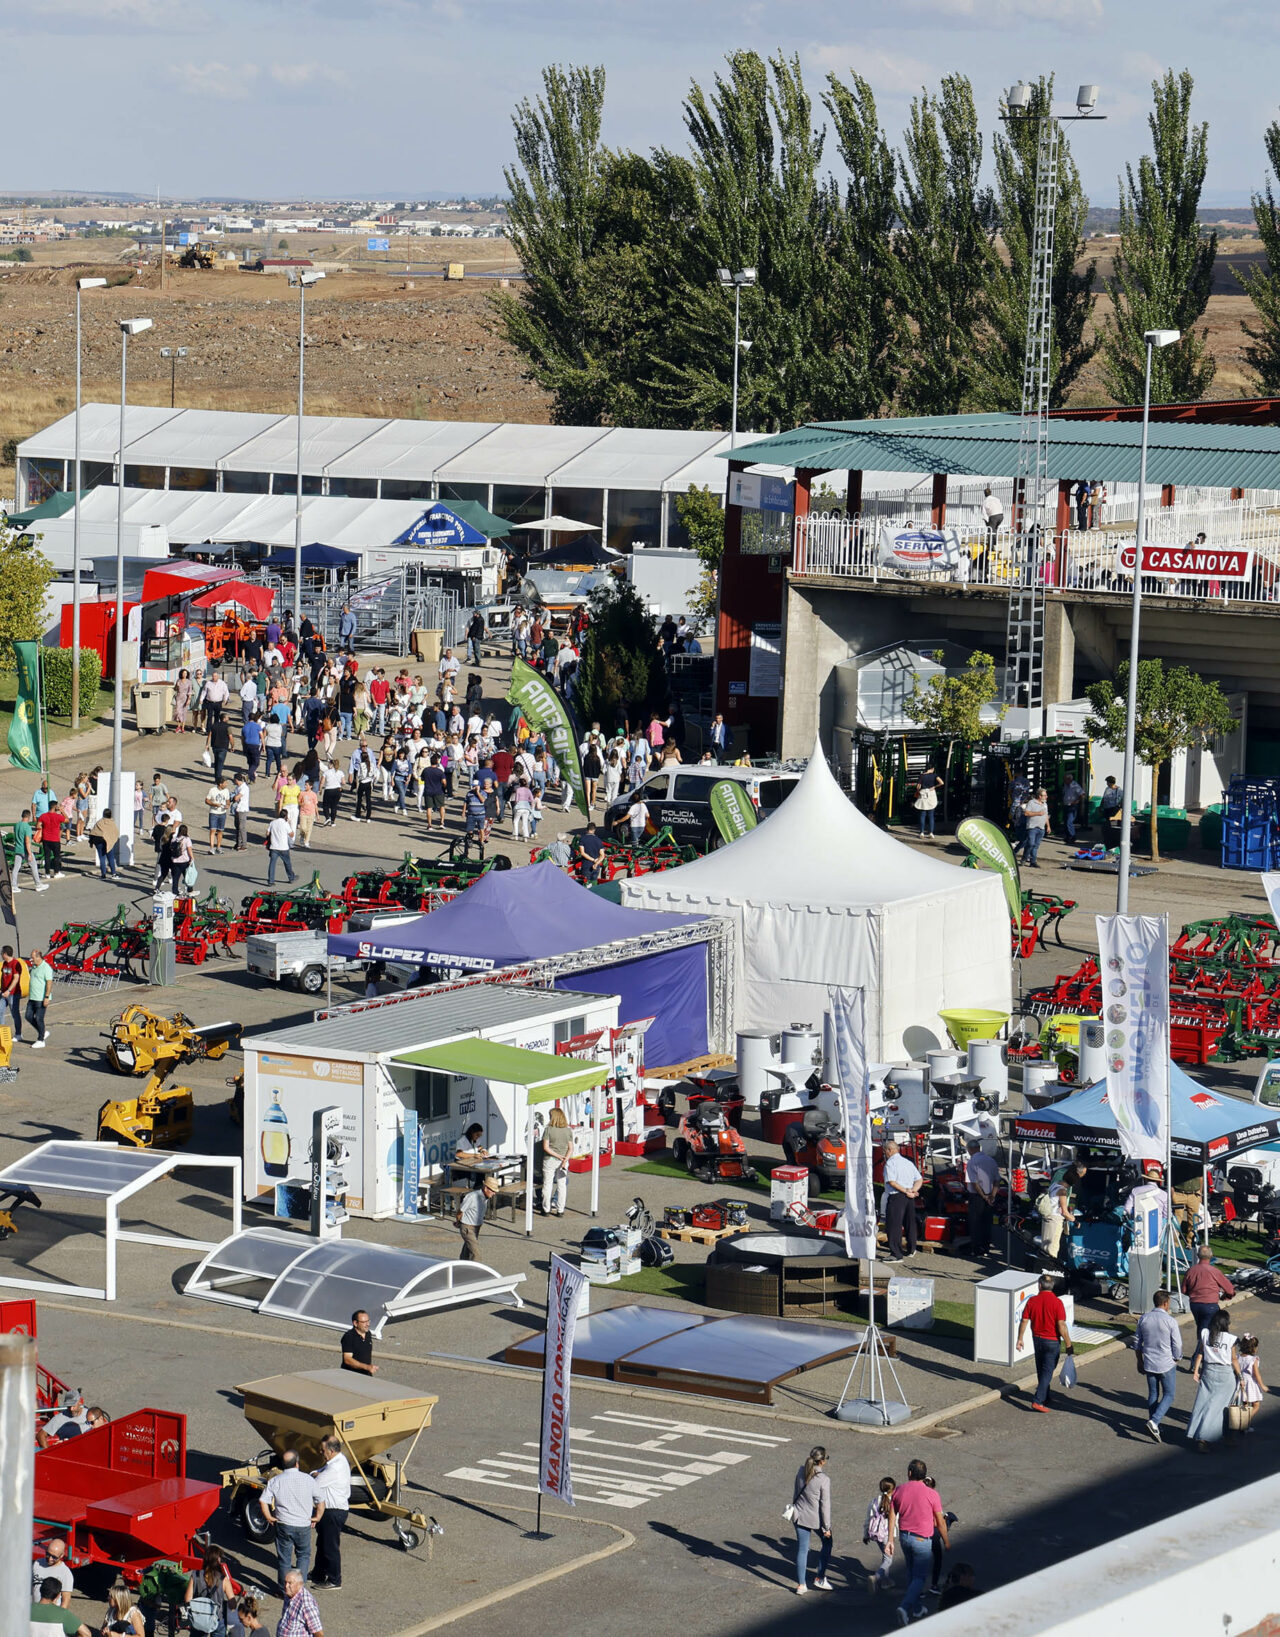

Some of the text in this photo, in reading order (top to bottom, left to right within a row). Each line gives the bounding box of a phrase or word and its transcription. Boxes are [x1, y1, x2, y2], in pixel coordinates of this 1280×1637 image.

[894, 541, 943, 551] SERNA
[1148, 551, 1240, 572] CASANOVA
[661, 817, 702, 826] NACIONAL
[371, 946, 425, 961] LOPEZ
[427, 952, 495, 970] GARRIDO
[546, 1398, 565, 1493] MANOLO
